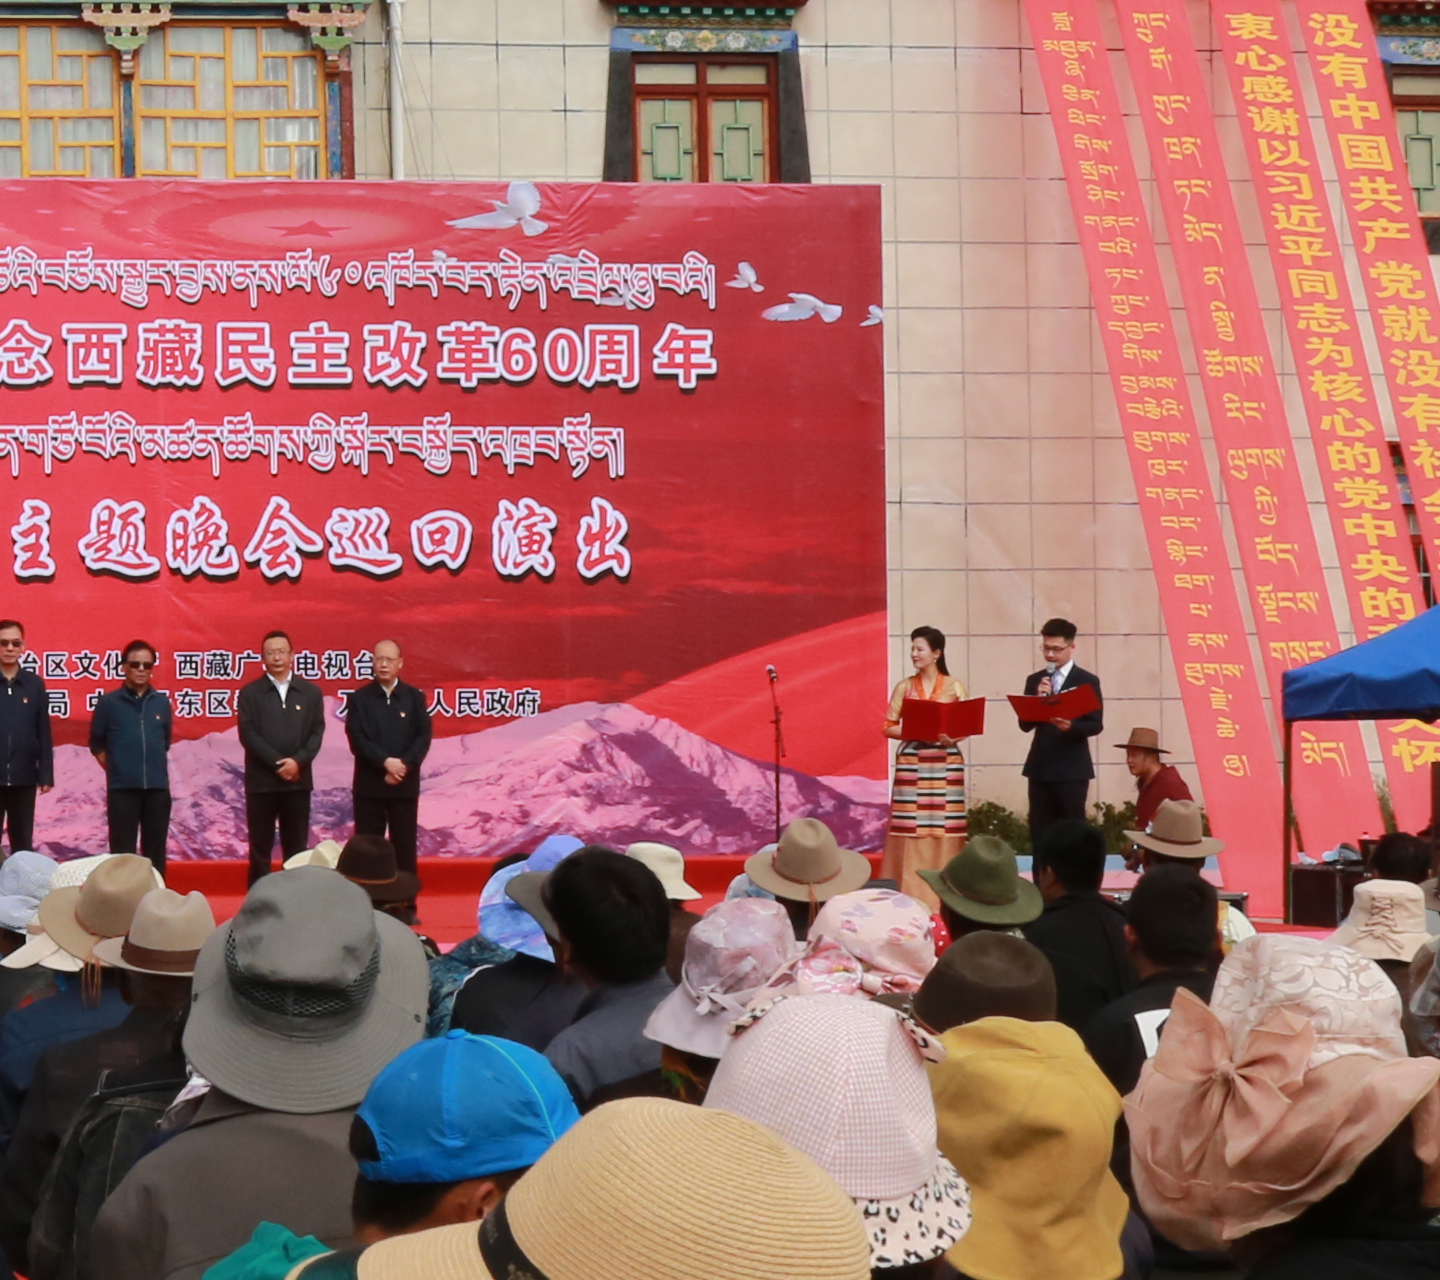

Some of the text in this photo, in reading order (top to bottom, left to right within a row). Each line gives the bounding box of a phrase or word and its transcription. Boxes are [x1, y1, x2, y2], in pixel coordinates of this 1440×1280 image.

[174, 651, 376, 681] 西藏广电视台
